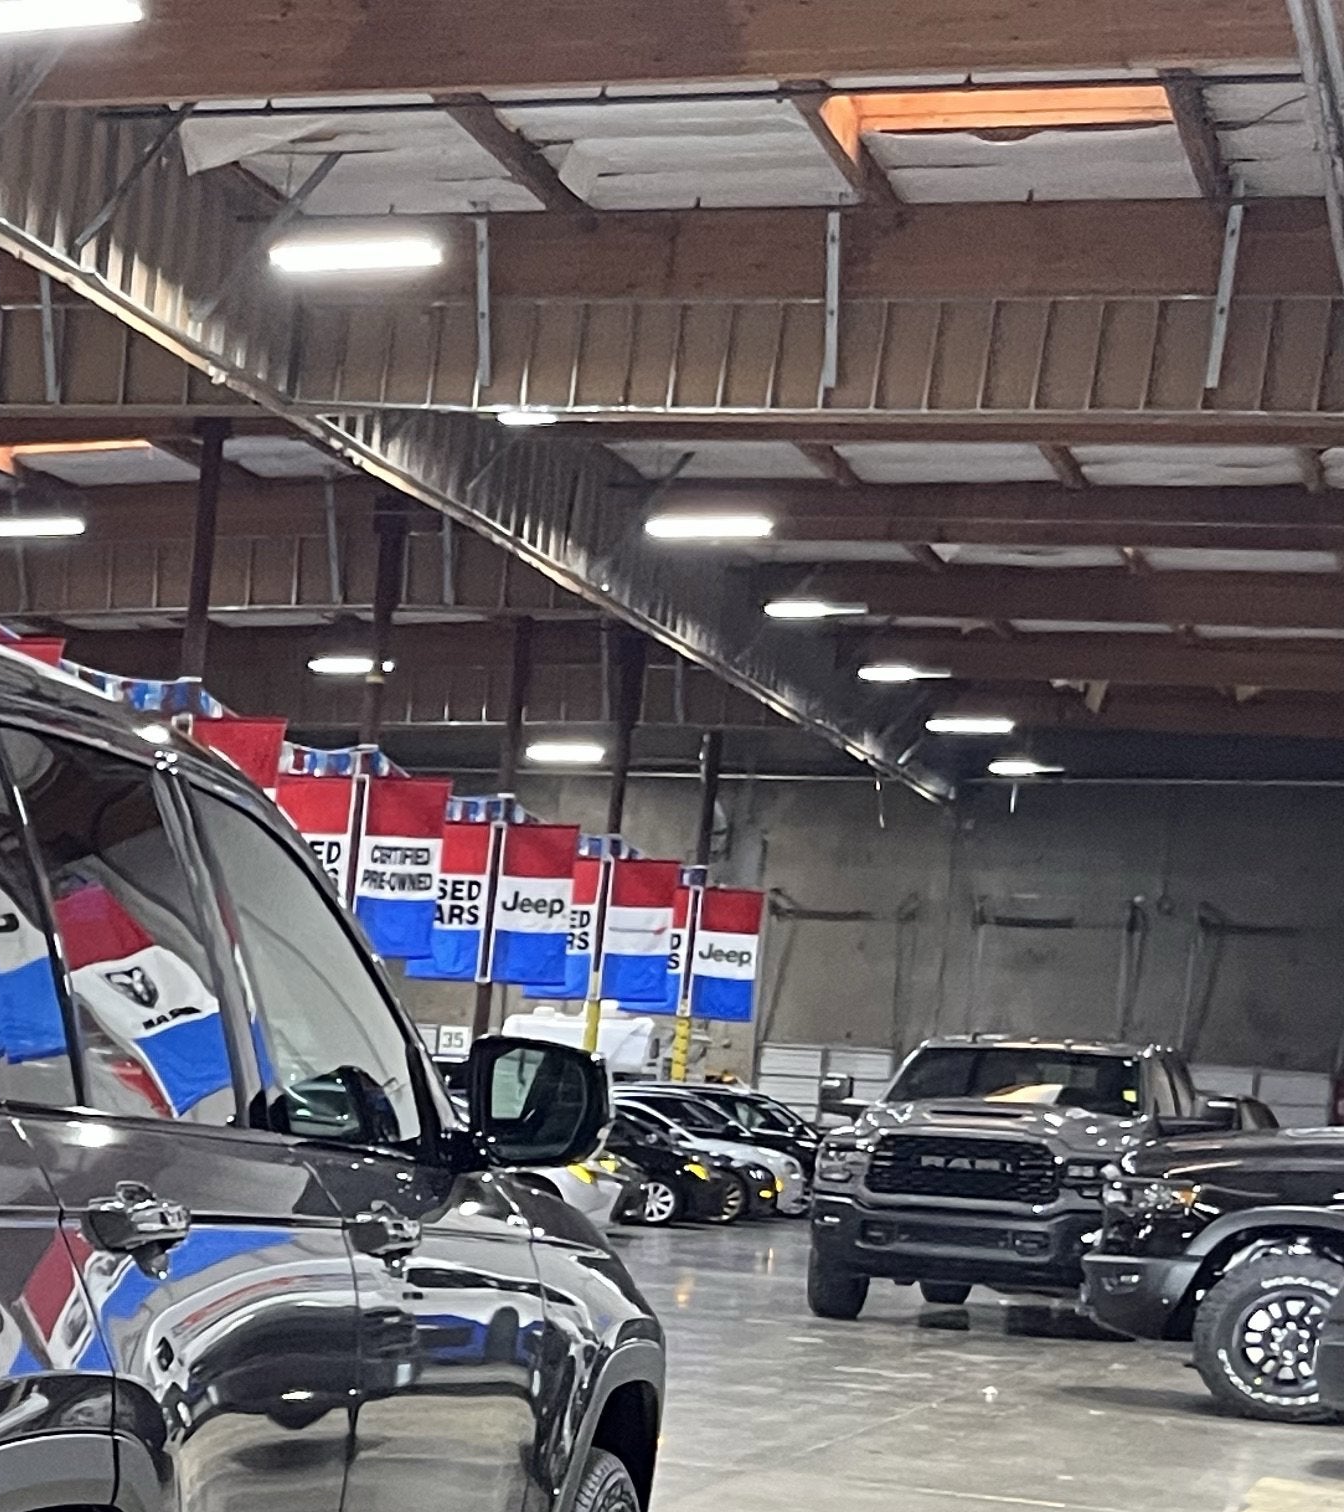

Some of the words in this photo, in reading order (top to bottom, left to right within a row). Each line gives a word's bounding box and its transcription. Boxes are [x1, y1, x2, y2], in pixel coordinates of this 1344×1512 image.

[309, 841, 341, 864] ED
[362, 869, 432, 891] PRE-OWNED
[437, 879, 481, 900] SED
[435, 904, 479, 925] ARS
[501, 891, 564, 918] Jeep
[698, 943, 752, 967] Jeep
[443, 1031, 464, 1049] 35
